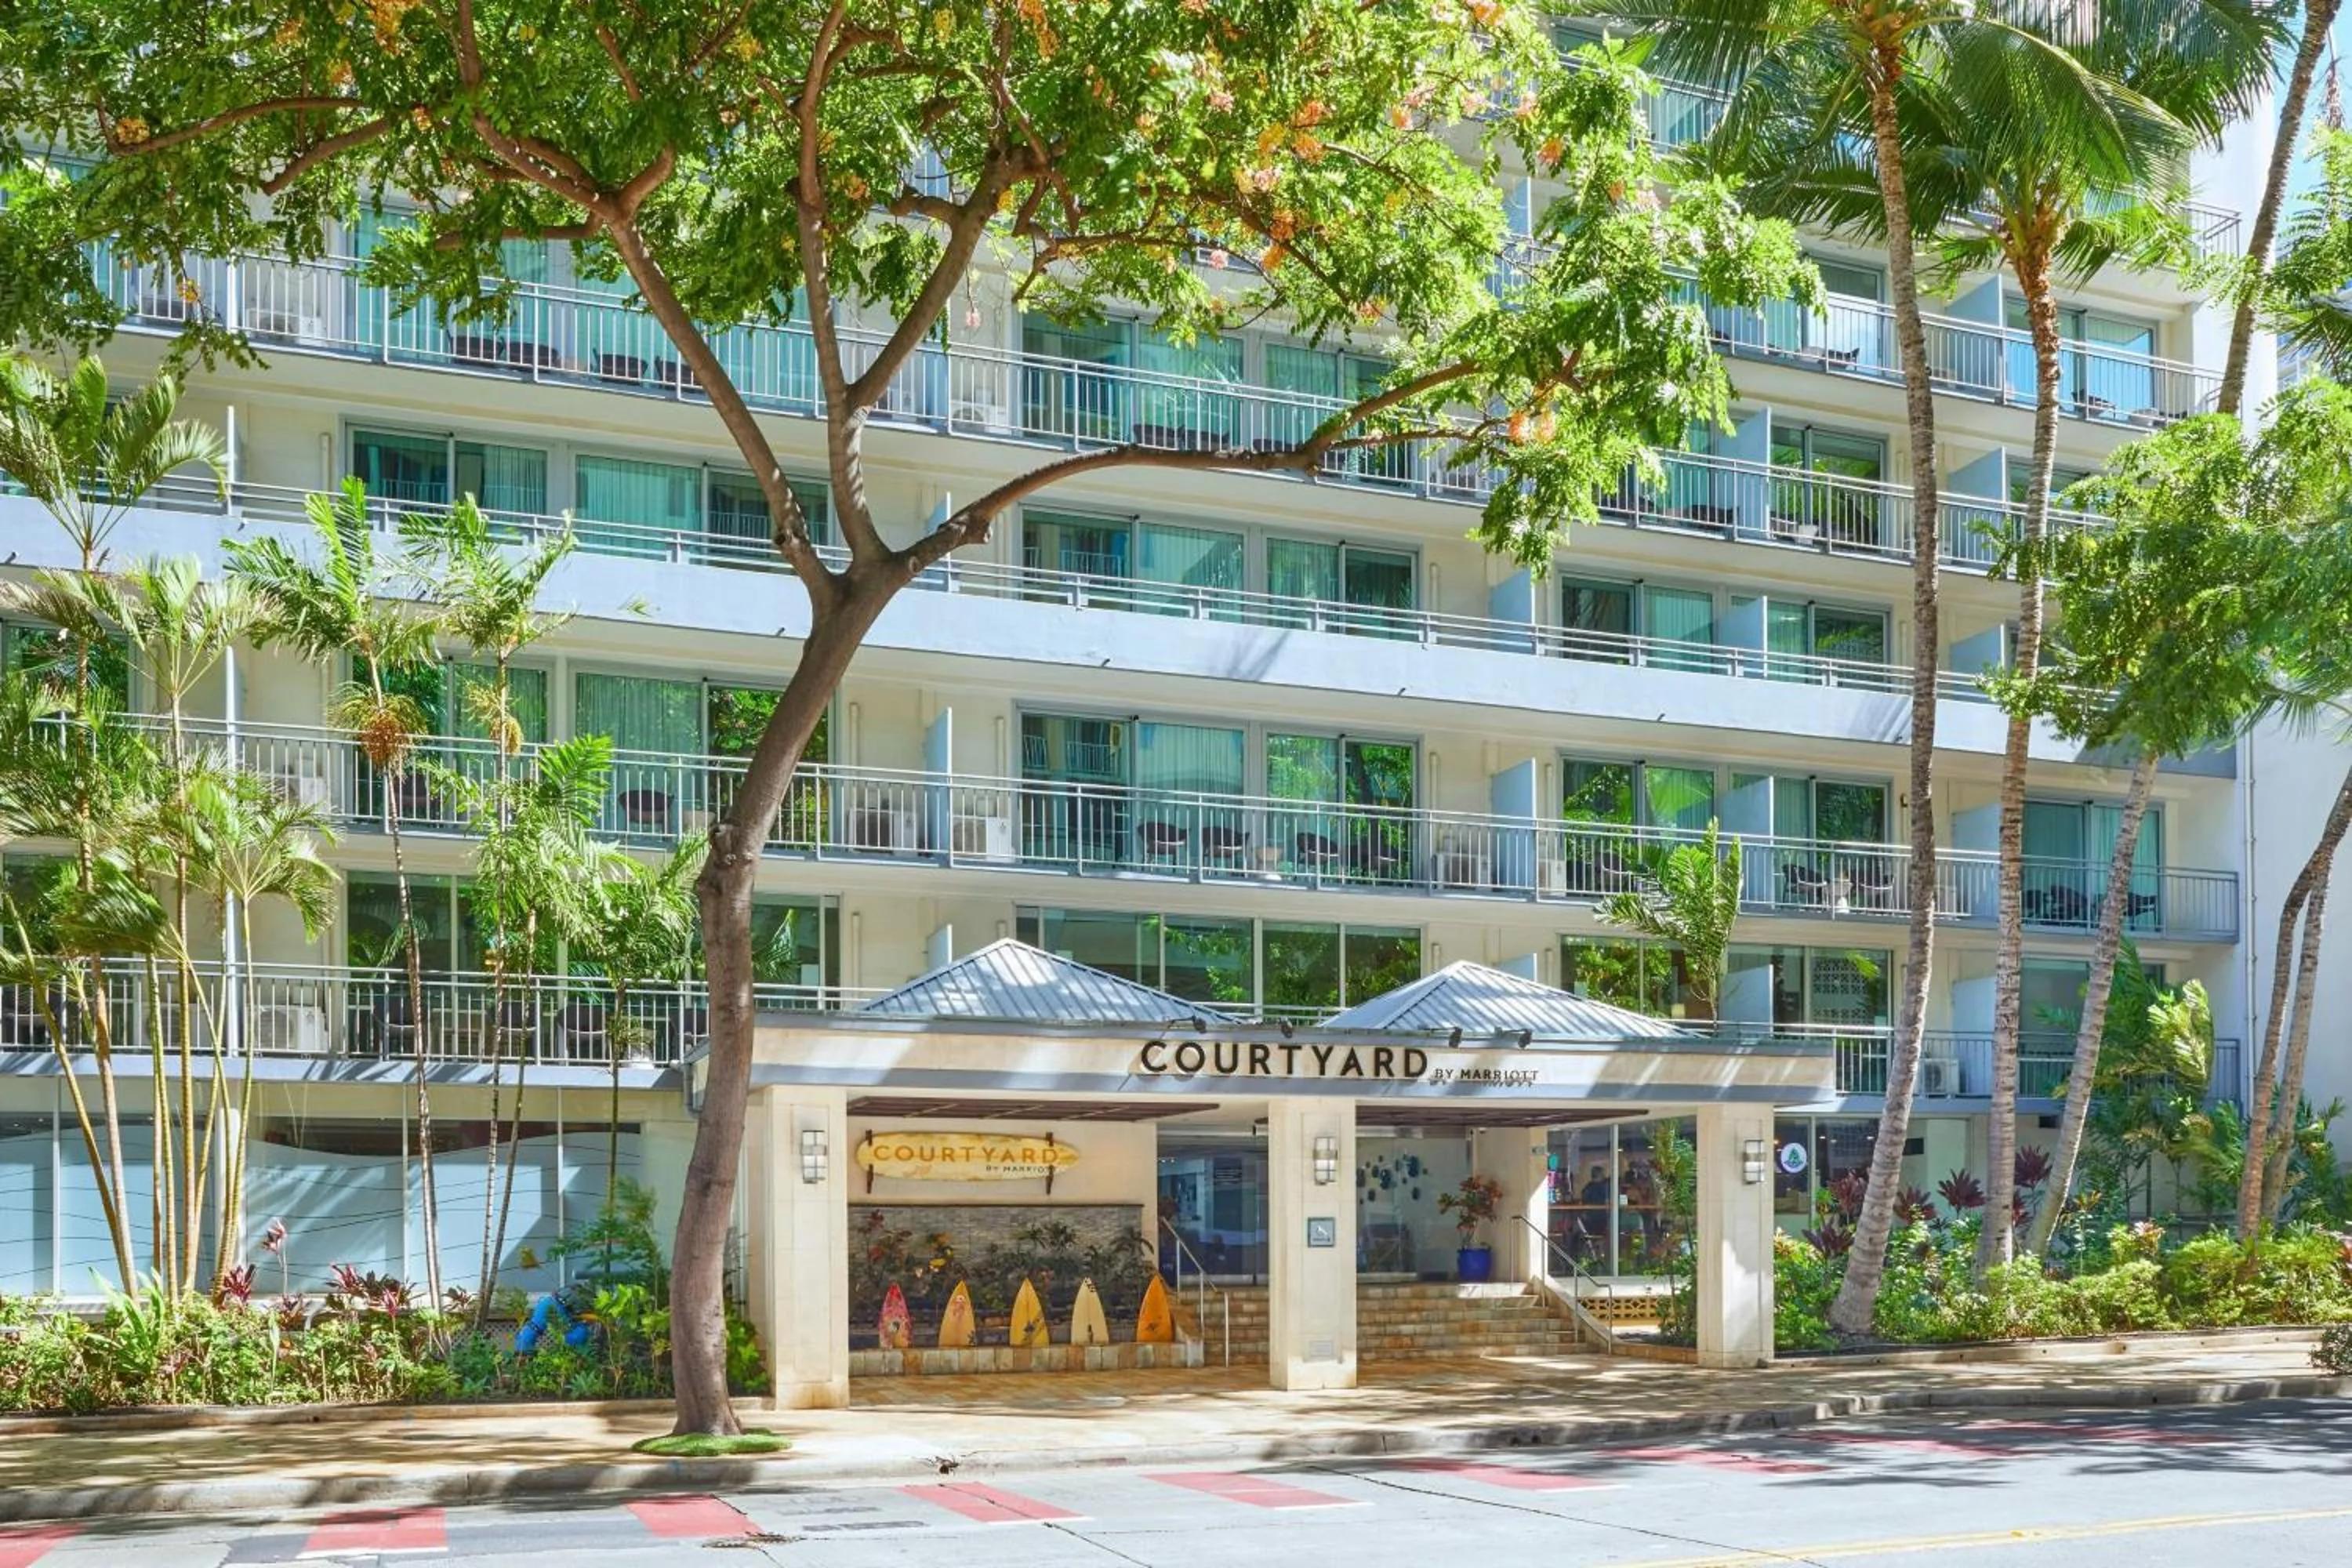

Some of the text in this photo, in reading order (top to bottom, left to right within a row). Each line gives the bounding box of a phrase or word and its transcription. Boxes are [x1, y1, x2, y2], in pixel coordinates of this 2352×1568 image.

[1141, 1040, 1539, 1080] COURTYARD BY MARRIOTT
[873, 1145, 1058, 1163] COURTYARD
